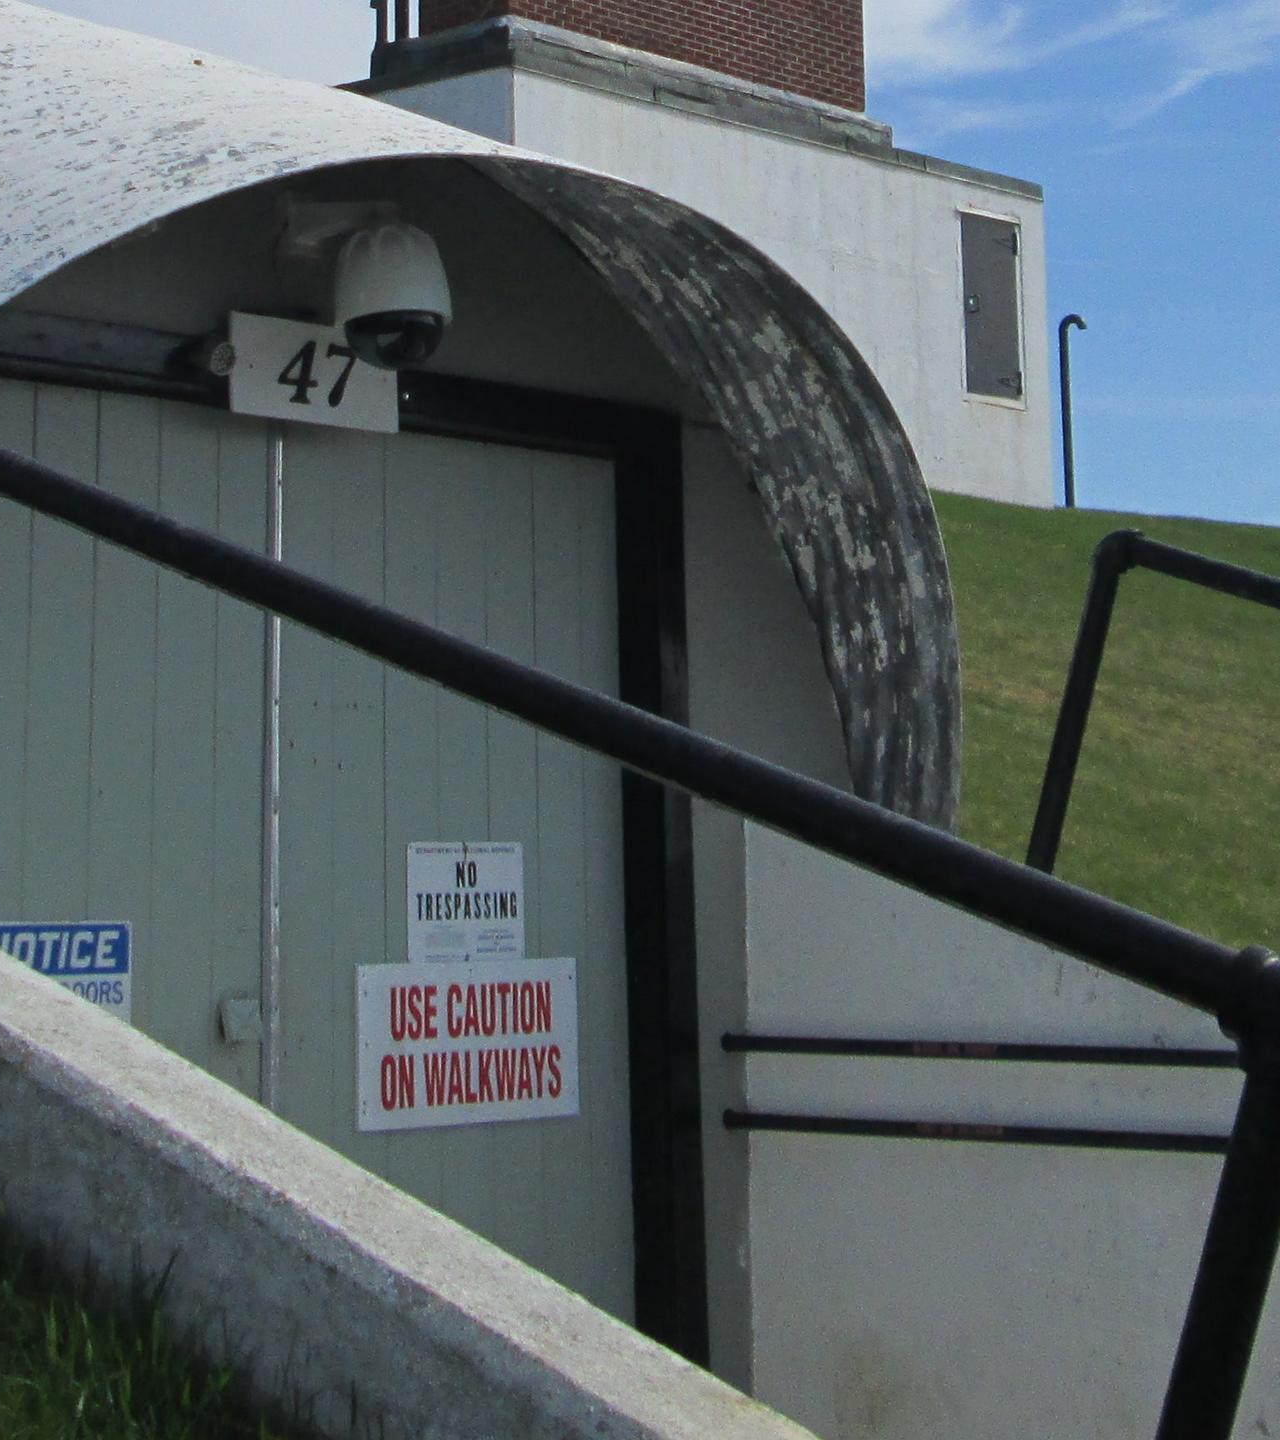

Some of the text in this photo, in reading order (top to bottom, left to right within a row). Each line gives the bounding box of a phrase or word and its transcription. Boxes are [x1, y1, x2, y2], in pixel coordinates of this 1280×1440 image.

[277, 339, 355, 407] 47
[456, 860, 477, 888] NO
[416, 891, 518, 920] TRESPASSING
[61, 980, 123, 1004] OORS
[390, 980, 552, 1041] USE CAUTION
[380, 1044, 562, 1111] ON WALKWAYS
